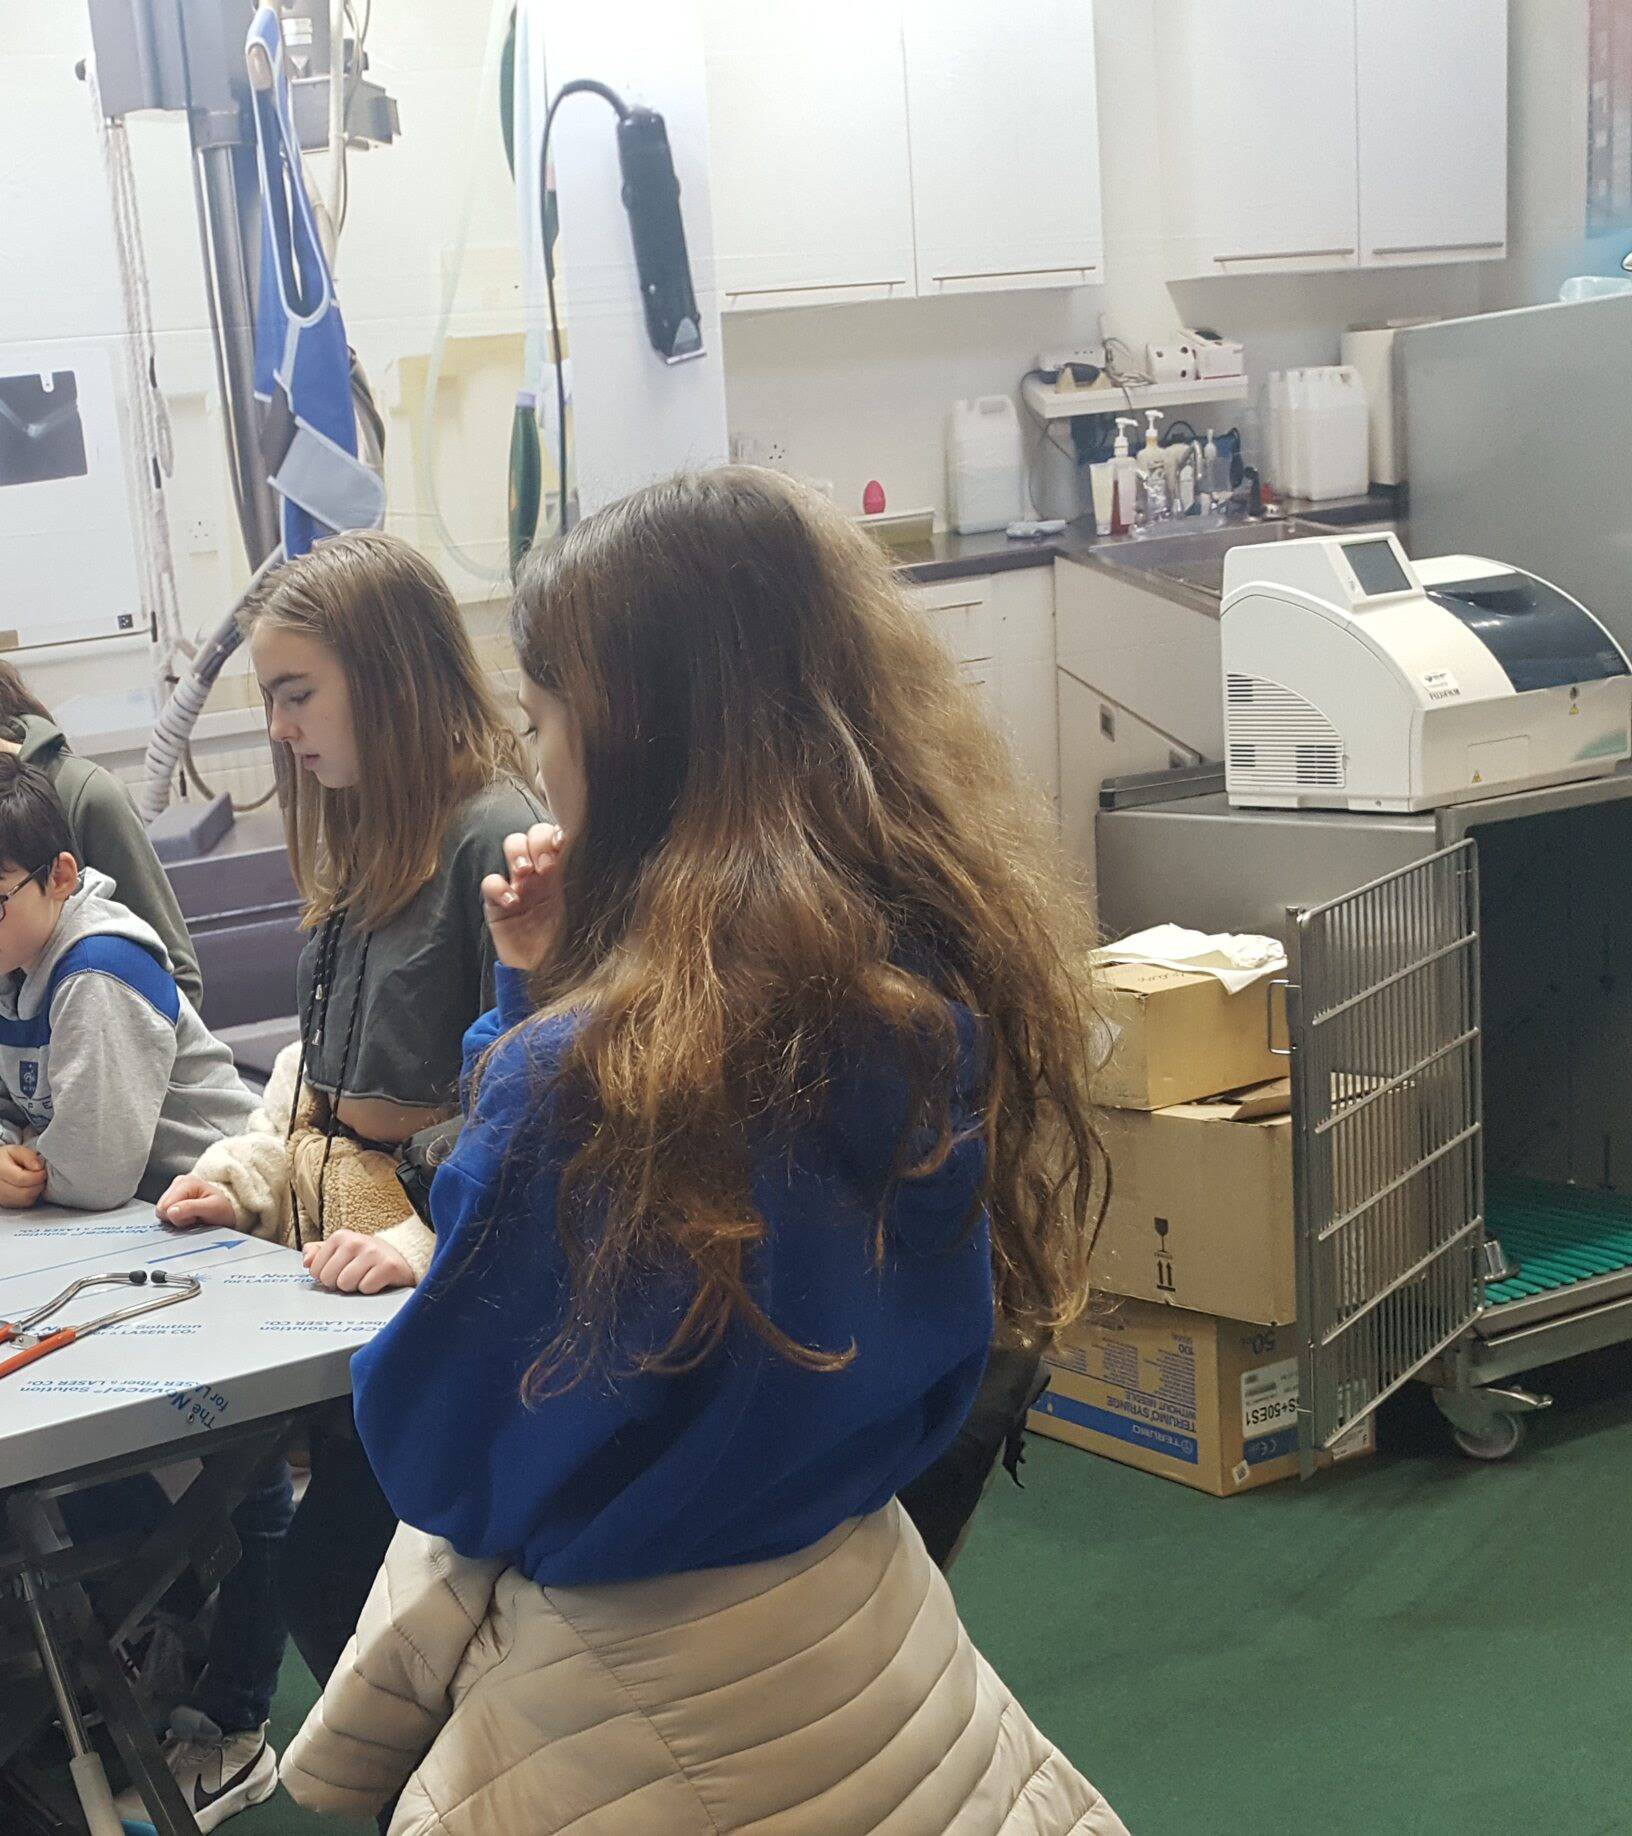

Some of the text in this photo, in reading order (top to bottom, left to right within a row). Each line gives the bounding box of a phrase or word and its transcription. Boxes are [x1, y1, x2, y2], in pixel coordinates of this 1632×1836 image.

[20, 1386, 90, 1394] Solution
[191, 1403, 217, 1430] The
[1246, 1398, 1300, 1426] S+50ES1
[1132, 1424, 1182, 1447] TERUMO
